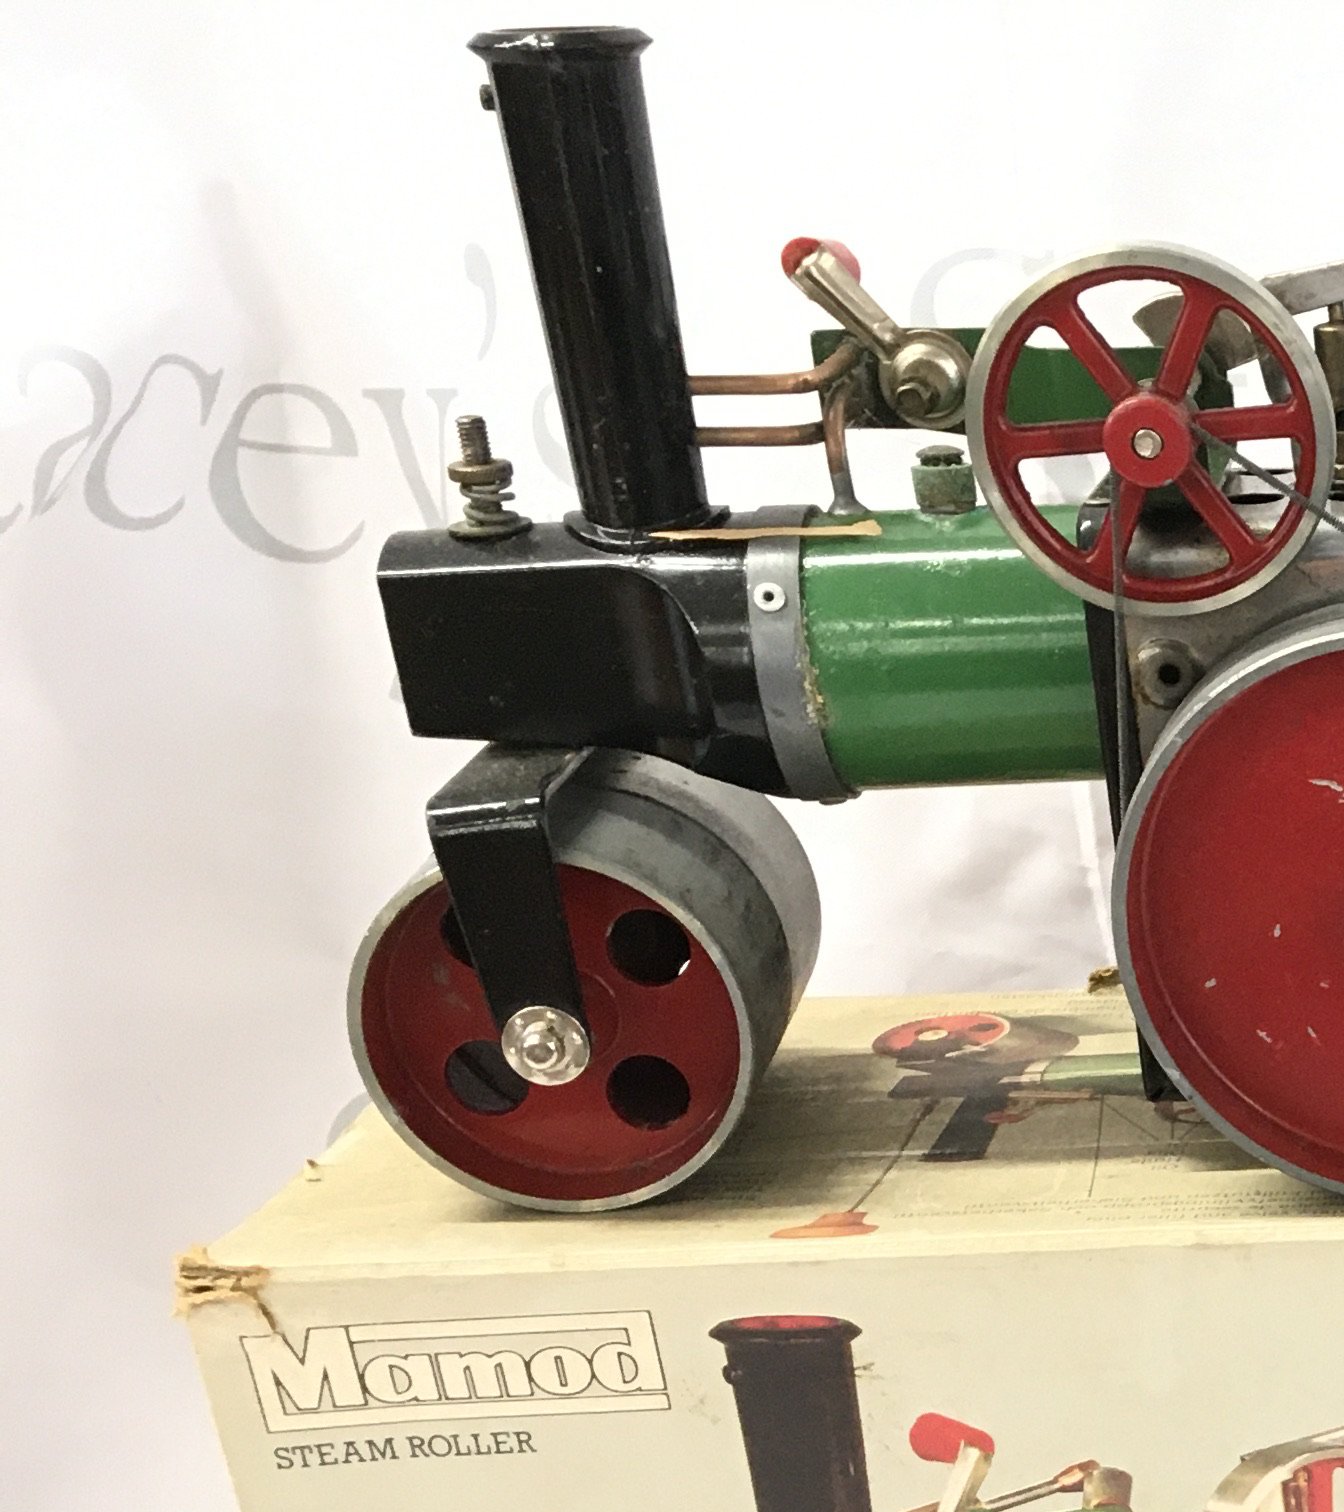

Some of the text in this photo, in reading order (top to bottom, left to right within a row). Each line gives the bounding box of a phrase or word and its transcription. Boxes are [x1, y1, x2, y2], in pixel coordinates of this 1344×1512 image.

[239, 1310, 671, 1433] Mamod
[273, 1430, 538, 1470] STEAM ROLLER
